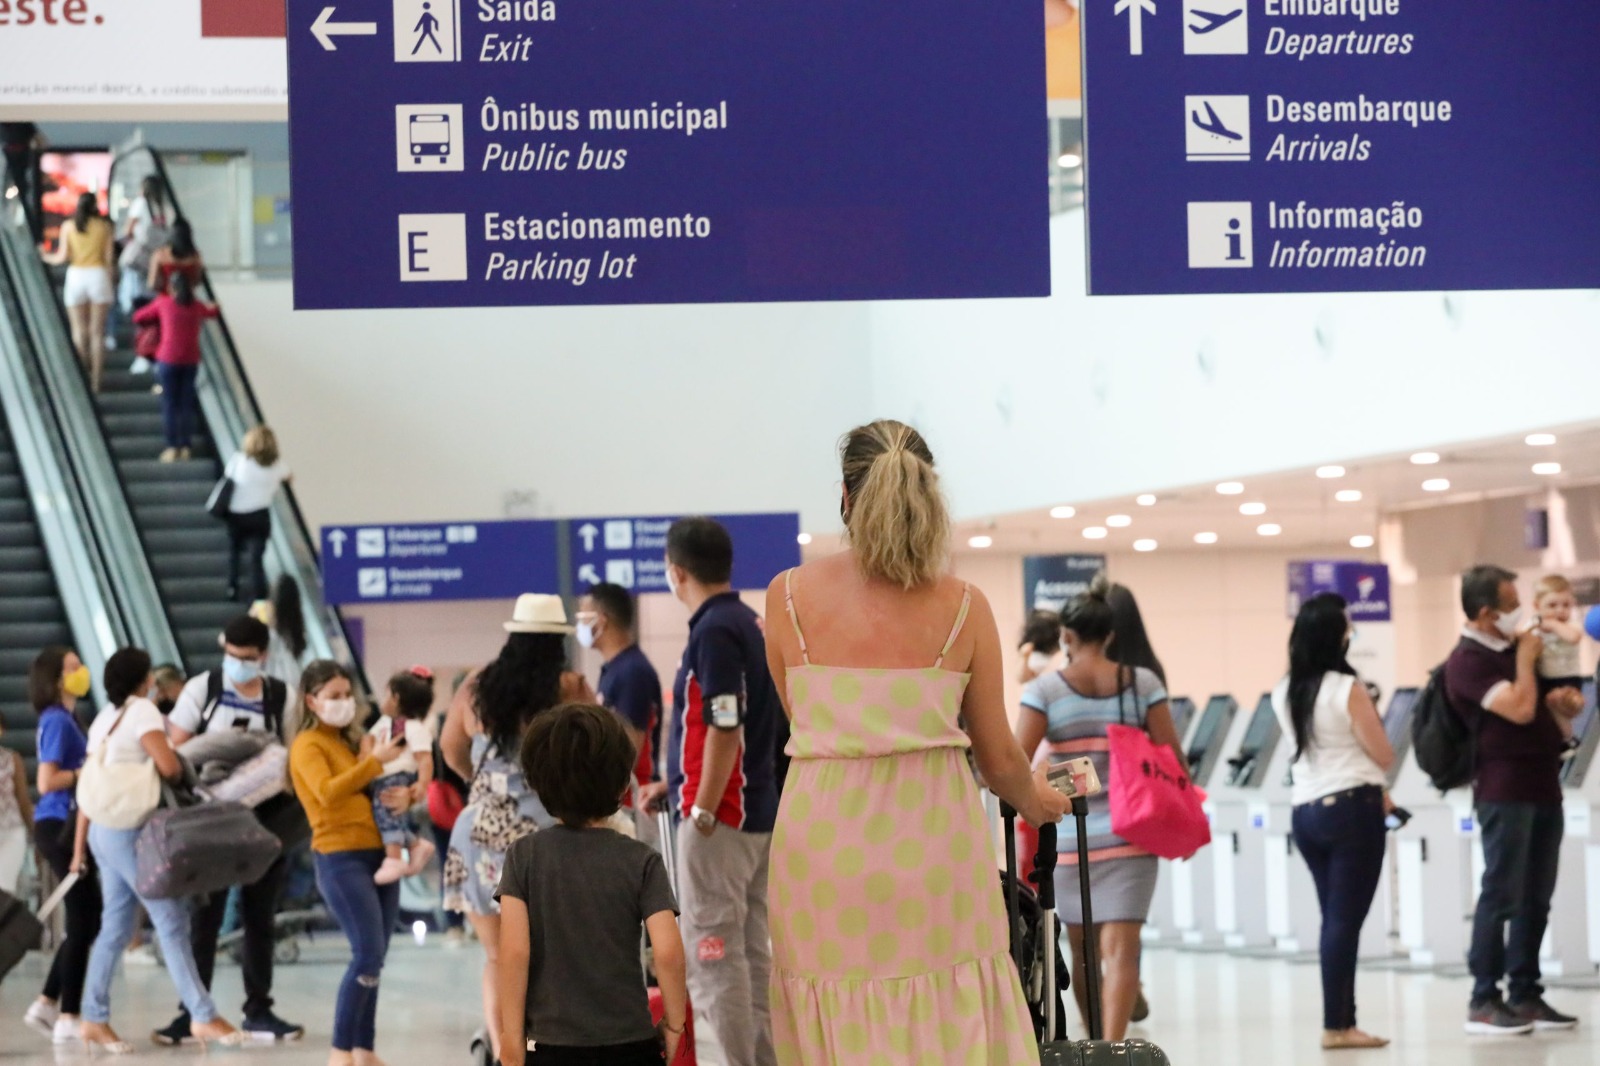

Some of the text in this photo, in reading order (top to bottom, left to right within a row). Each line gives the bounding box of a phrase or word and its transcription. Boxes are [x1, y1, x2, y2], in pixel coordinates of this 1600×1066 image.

[480, 33, 533, 62] Exit
[1264, 27, 1415, 61] Departures
[0, 81, 49, 97] ariação
[481, 96, 727, 136] Ônibus municipal
[1266, 94, 1452, 128] Desembarque
[482, 142, 628, 171] Public bus
[1265, 133, 1372, 162] Arrivals
[485, 212, 711, 240] Estacionamento
[1269, 200, 1423, 235] Informação
[408, 231, 430, 273] E
[1269, 239, 1427, 268] Information
[485, 251, 638, 286] Parking lot
